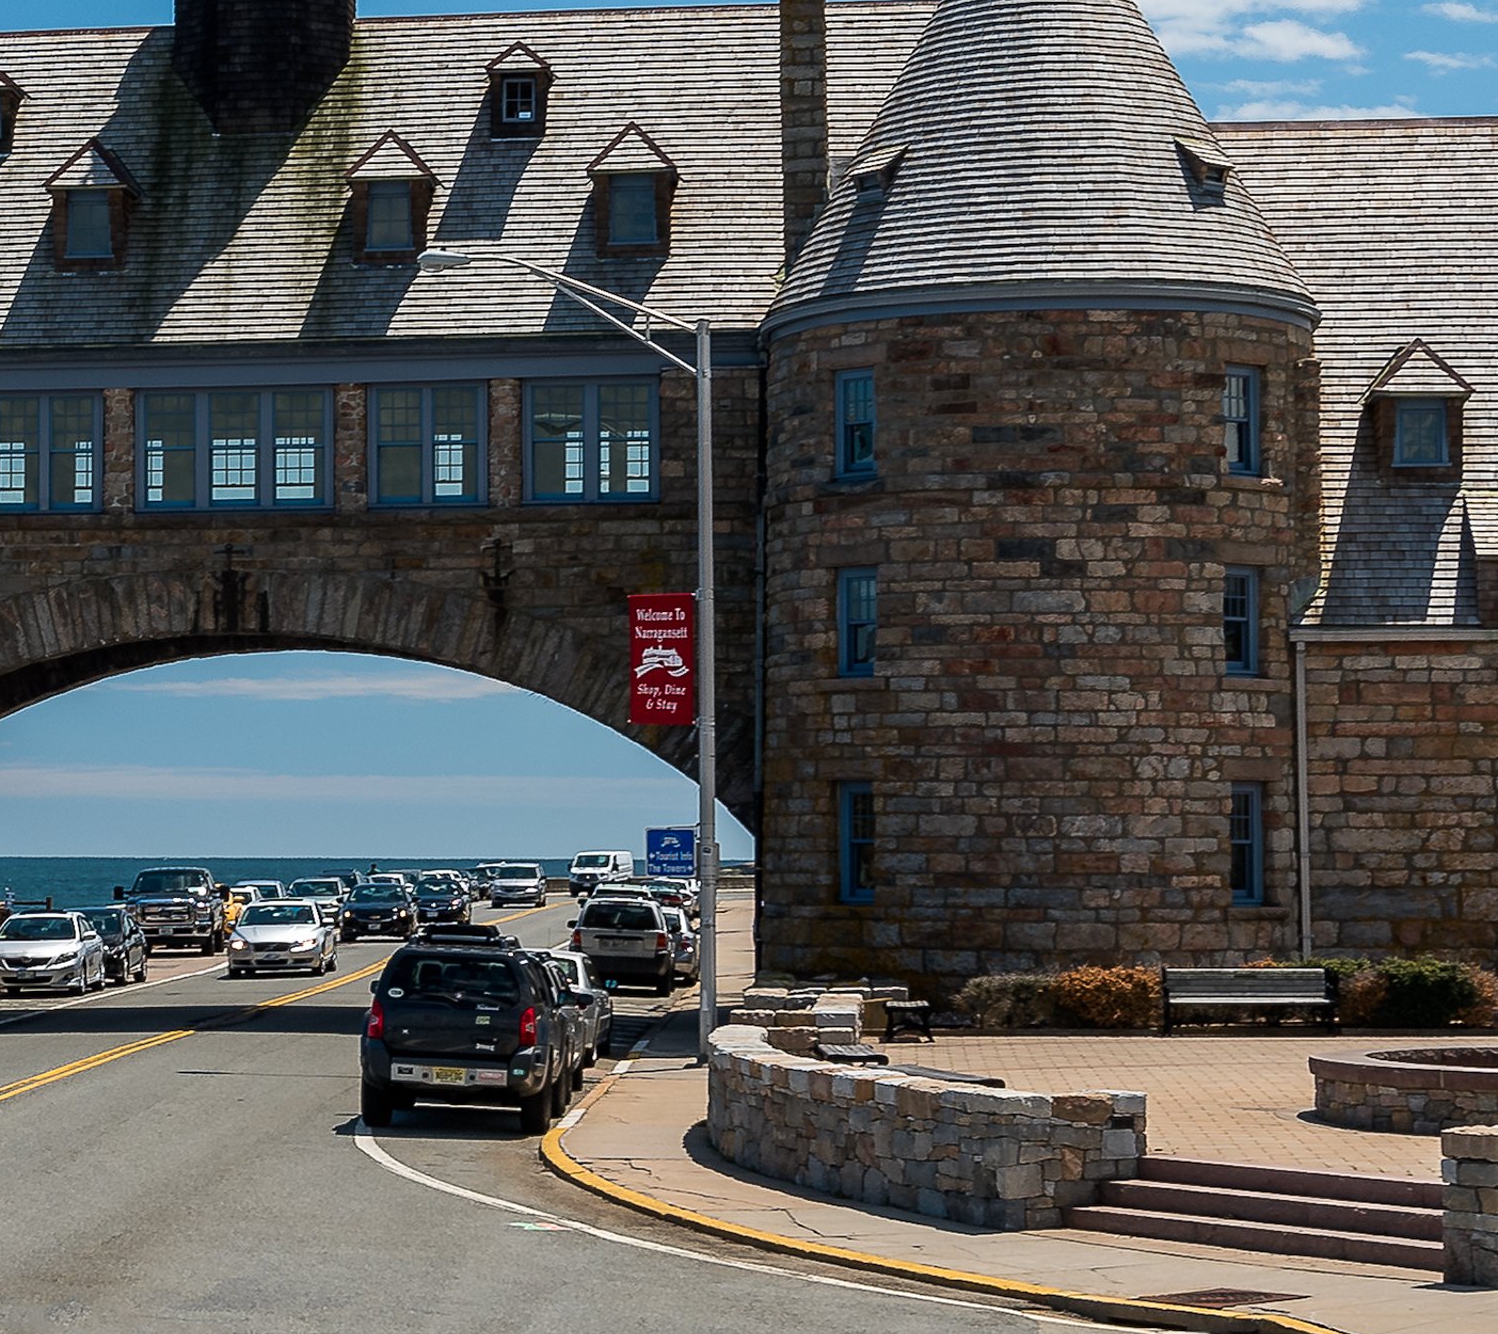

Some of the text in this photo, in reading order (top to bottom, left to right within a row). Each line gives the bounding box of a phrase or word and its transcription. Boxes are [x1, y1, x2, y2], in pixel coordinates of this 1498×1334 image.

[636, 607, 686, 622] Welcome To
[634, 626, 688, 643] Narragansett
[637, 683, 686, 698] Shop, Dine
[656, 698, 677, 714] Stay
[655, 851, 679, 861] Tourist
